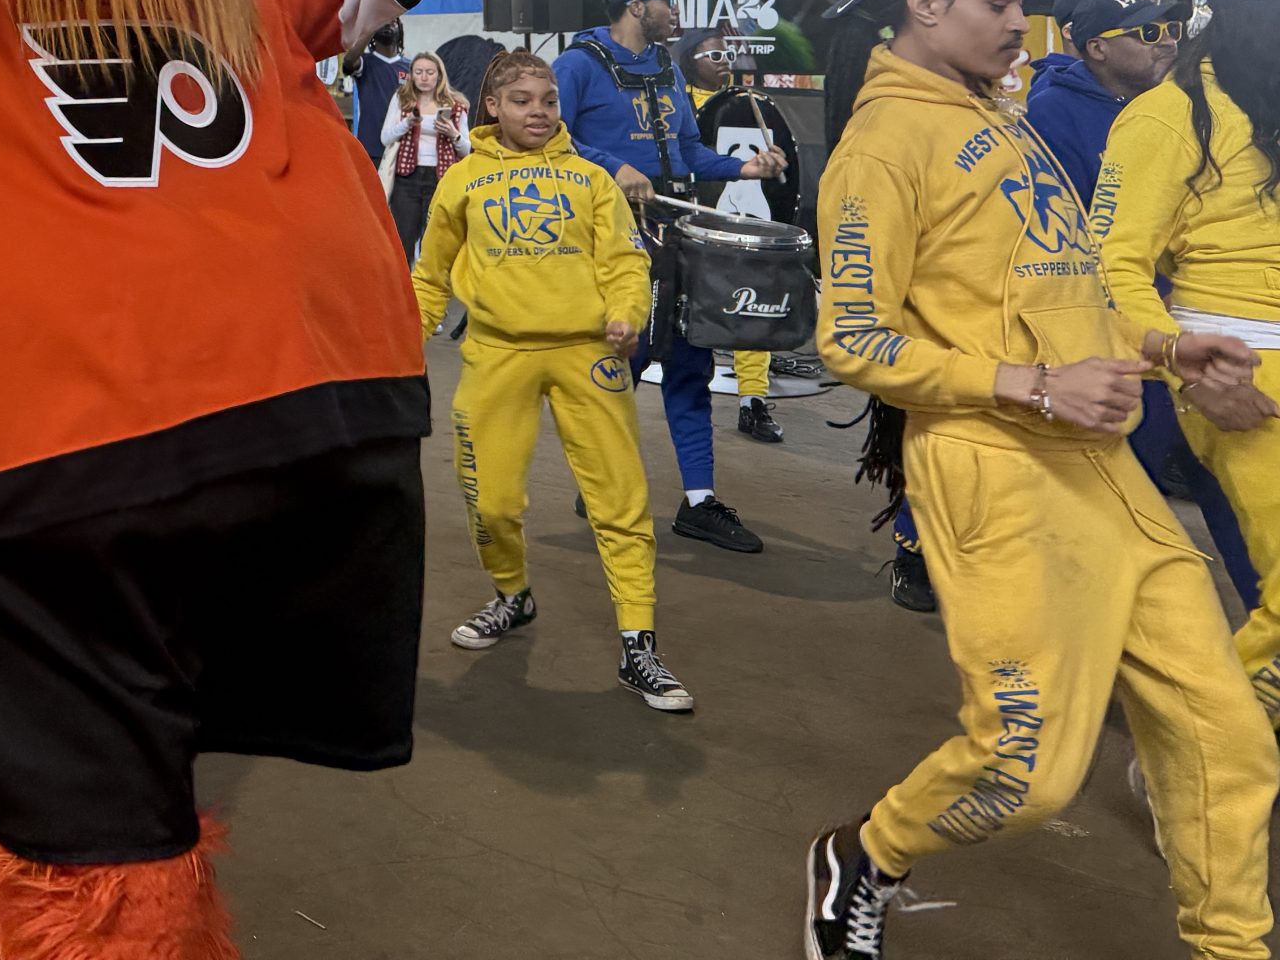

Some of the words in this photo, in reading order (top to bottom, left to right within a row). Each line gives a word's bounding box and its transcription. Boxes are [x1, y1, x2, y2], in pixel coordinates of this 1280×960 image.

[749, 45, 775, 54] TRIP
[954, 128, 999, 173] WEST
[465, 171, 504, 192] WEST
[830, 222, 873, 294] WEST
[1014, 261, 1071, 278] STEPPERS
[723, 287, 790, 315] Pearl
[994, 689, 1044, 773] WEST
